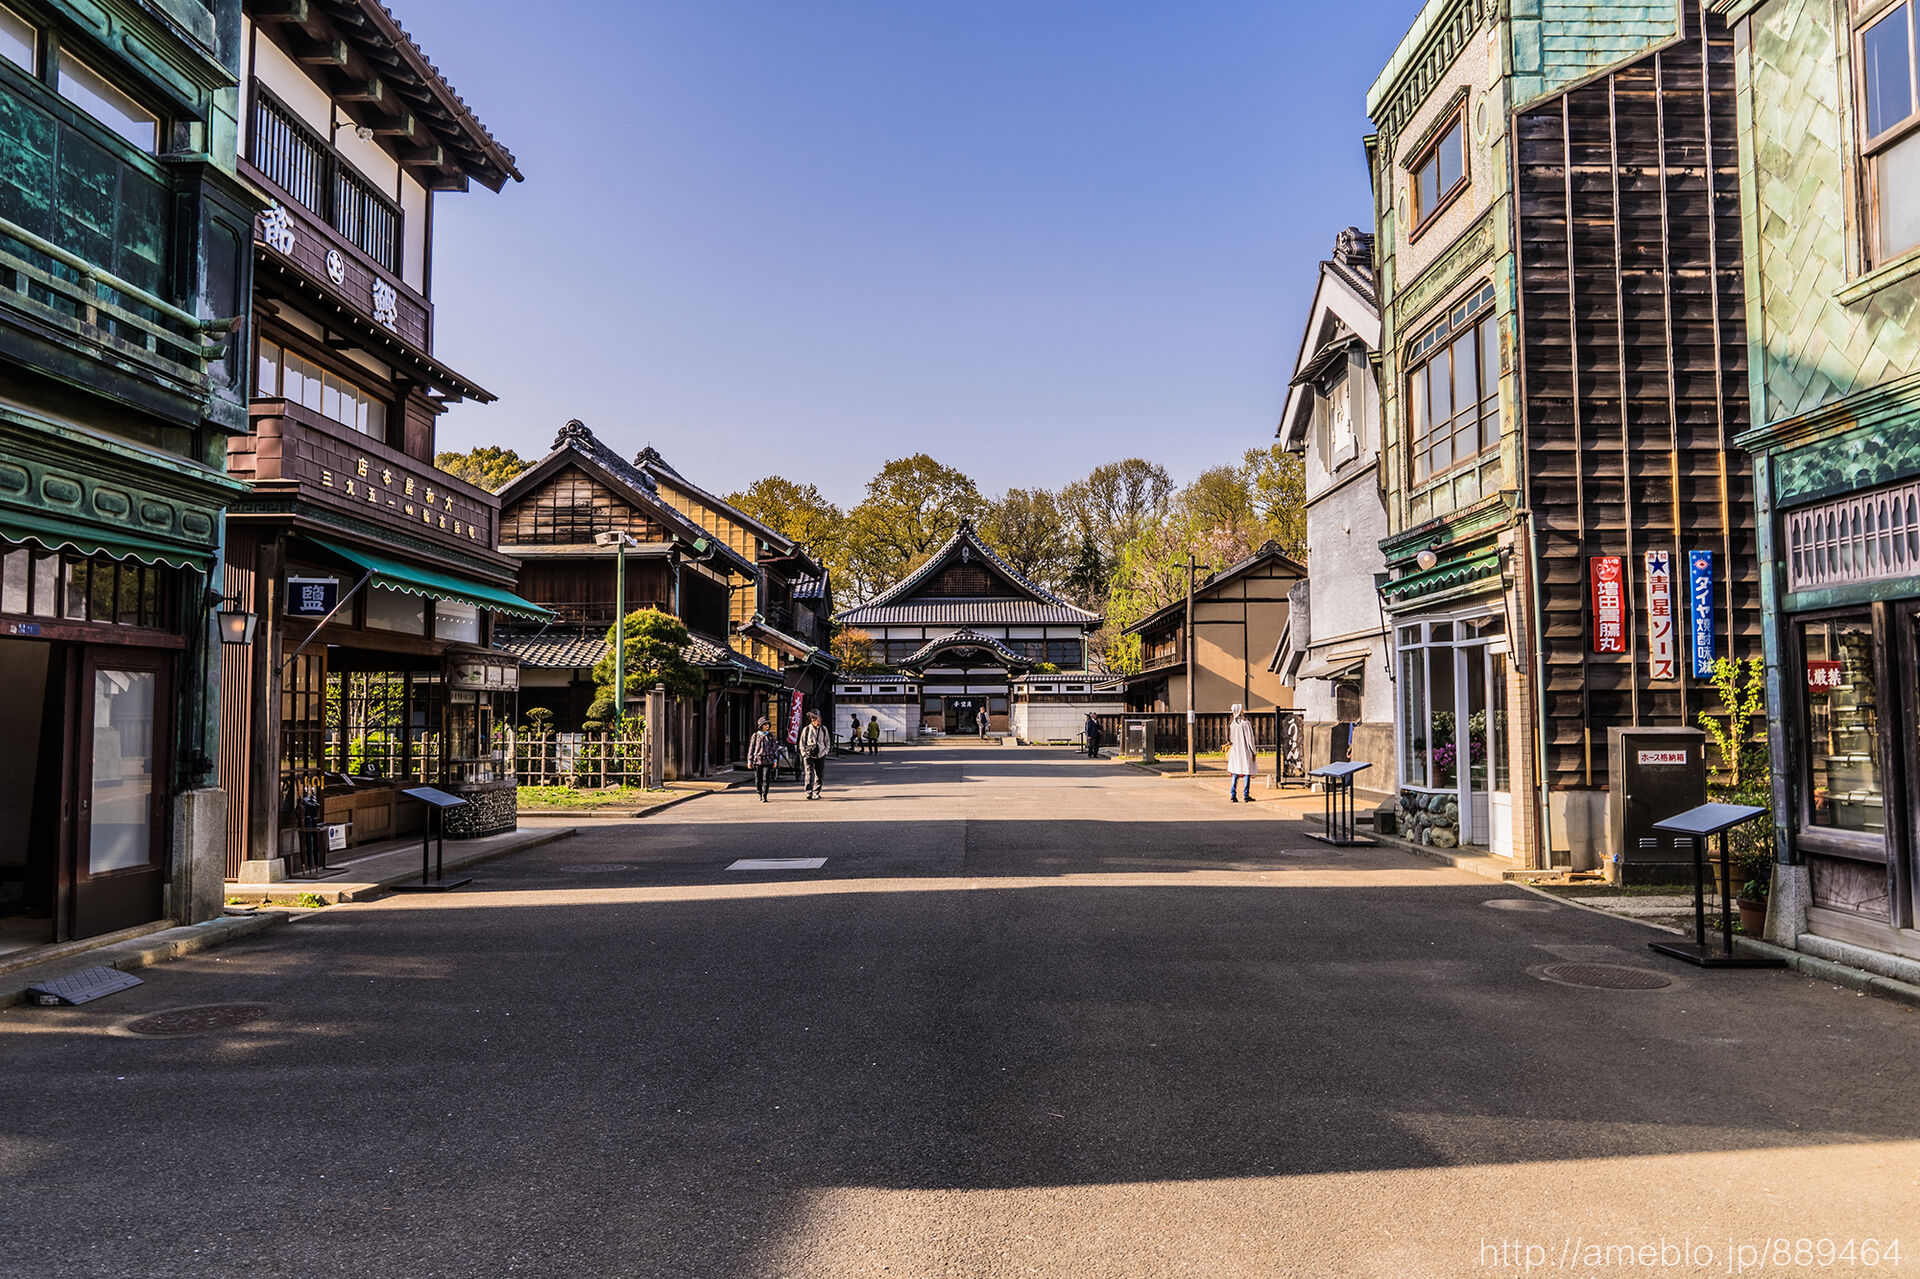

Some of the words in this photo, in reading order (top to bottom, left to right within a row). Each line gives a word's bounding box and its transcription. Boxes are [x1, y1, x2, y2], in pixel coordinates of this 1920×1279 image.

[1650, 575, 1673, 678] 青星ソース
[1641, 753, 1685, 762] ホース格納箱
